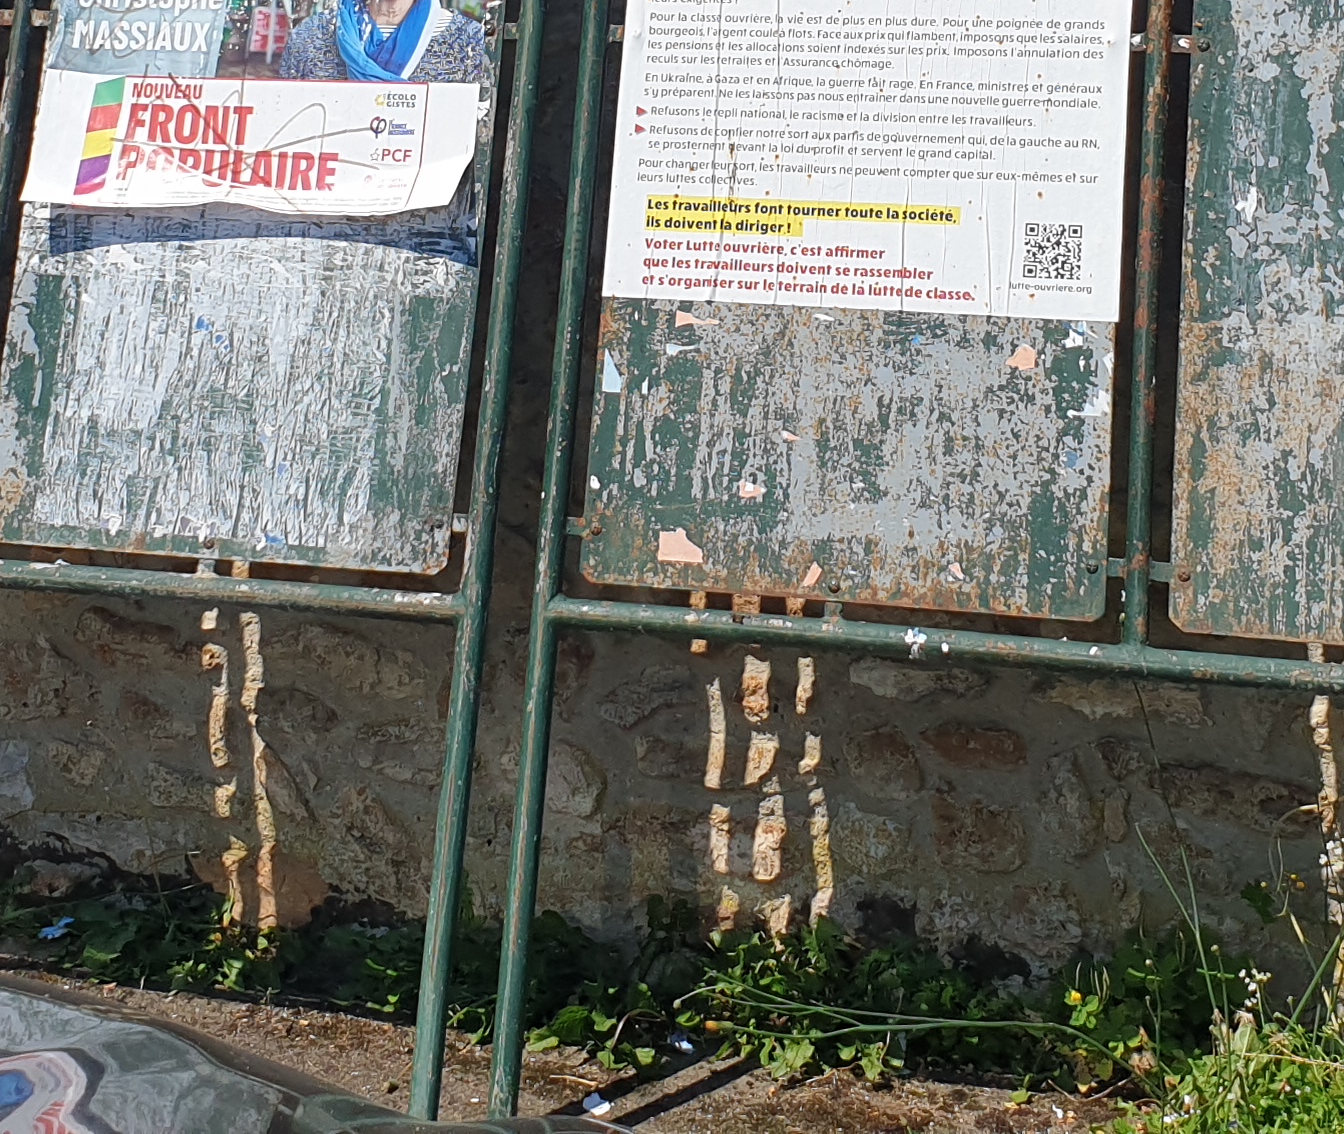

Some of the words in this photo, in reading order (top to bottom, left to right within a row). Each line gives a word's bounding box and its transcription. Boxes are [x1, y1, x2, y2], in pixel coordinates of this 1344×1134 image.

[72, 19, 210, 52] MASSIAUX
[132, 83, 203, 101] NOUVEAU
[126, 103, 254, 146] FRONT
[381, 148, 412, 162] PCF
[648, 199, 669, 210] Les
[672, 200, 751, 214] travailleurs
[755, 202, 782, 215] font
[787, 203, 841, 216] tourner
[845, 207, 883, 218] toute
[887, 208, 899, 219] la
[902, 209, 957, 224] société,
[664, 217, 717, 230] doivent
[720, 219, 732, 231] la
[736, 219, 784, 234] diriger
[645, 238, 683, 250] Voter
[724, 241, 787, 256] ouvrière,
[791, 244, 821, 256] c'est
[826, 245, 885, 259] affirmer
